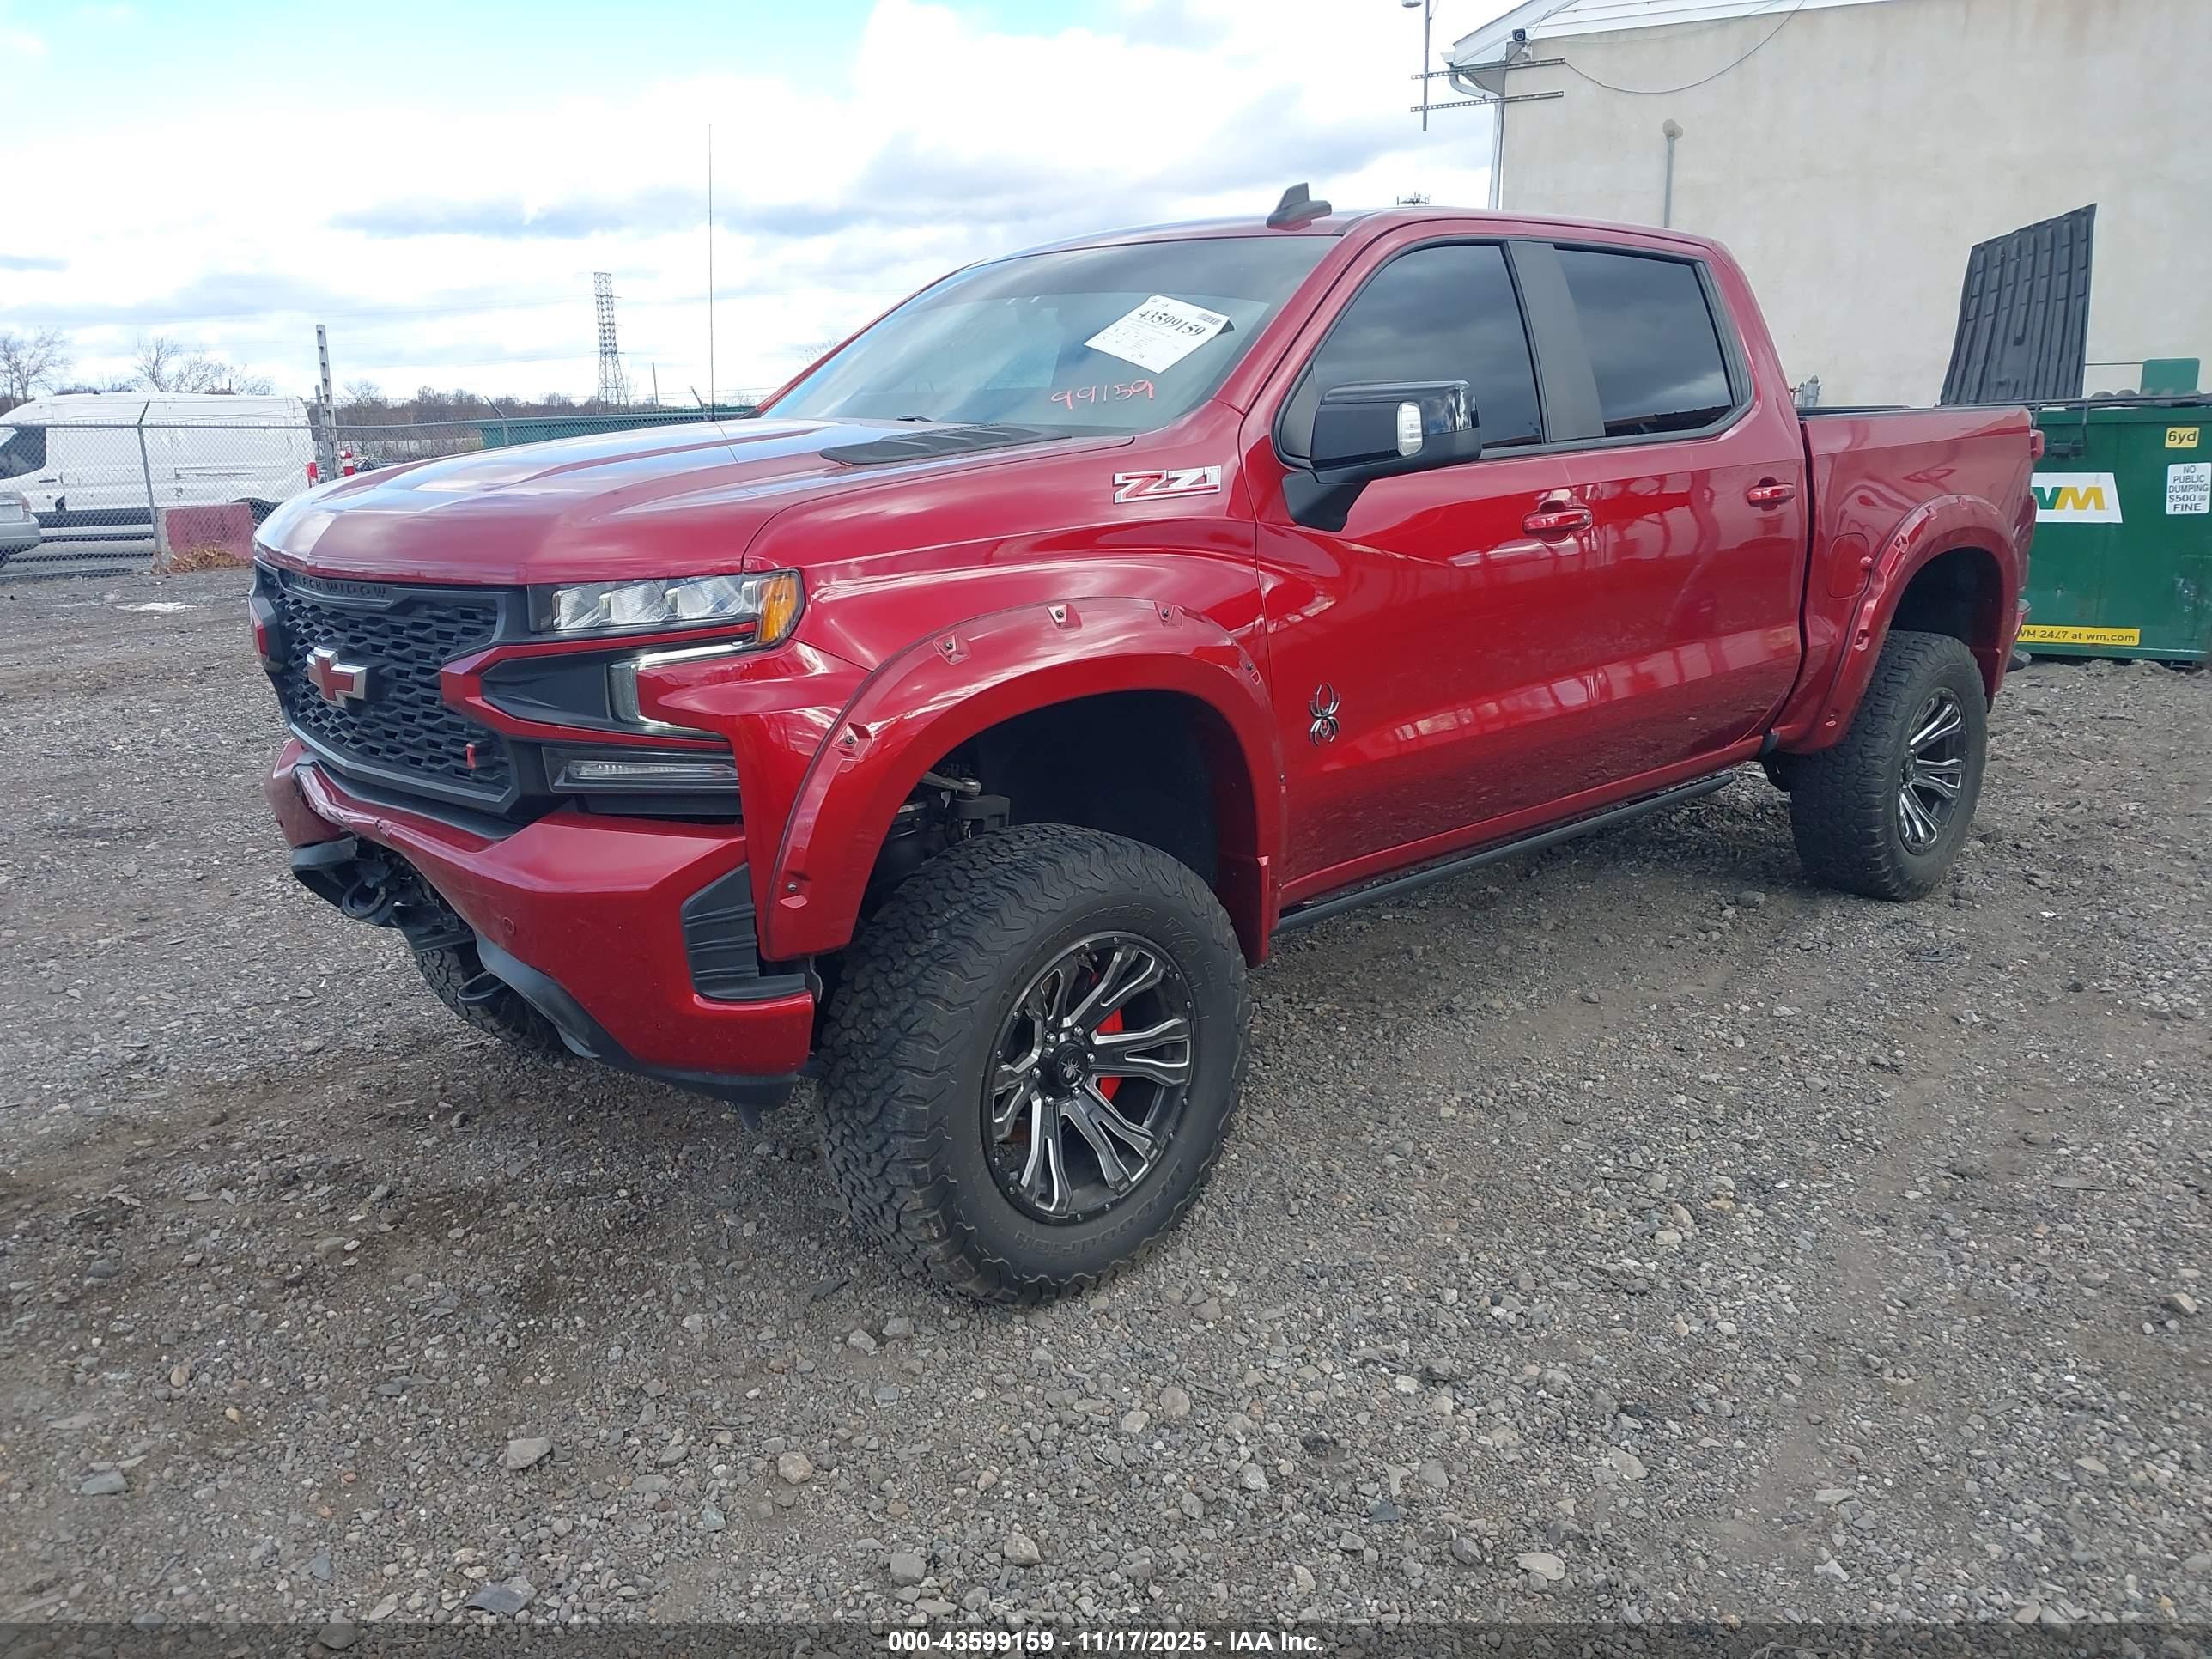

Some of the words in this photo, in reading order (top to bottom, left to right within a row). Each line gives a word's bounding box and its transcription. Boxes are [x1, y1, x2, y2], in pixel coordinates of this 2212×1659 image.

[1138, 309, 1206, 337] 43599159
[1050, 379, 1155, 410] 99159
[2168, 430, 2197, 445] 6yd
[2183, 465, 2197, 474] NO
[2173, 475, 2206, 483] PUBLIC
[2168, 483, 2209, 494] DUMPING
[2168, 494, 2197, 503] $500
[2173, 503, 2203, 513] FINE
[2039, 630, 2069, 640] 24/7
[2071, 631, 2082, 640] at
[2087, 634, 2136, 642] wm.com
